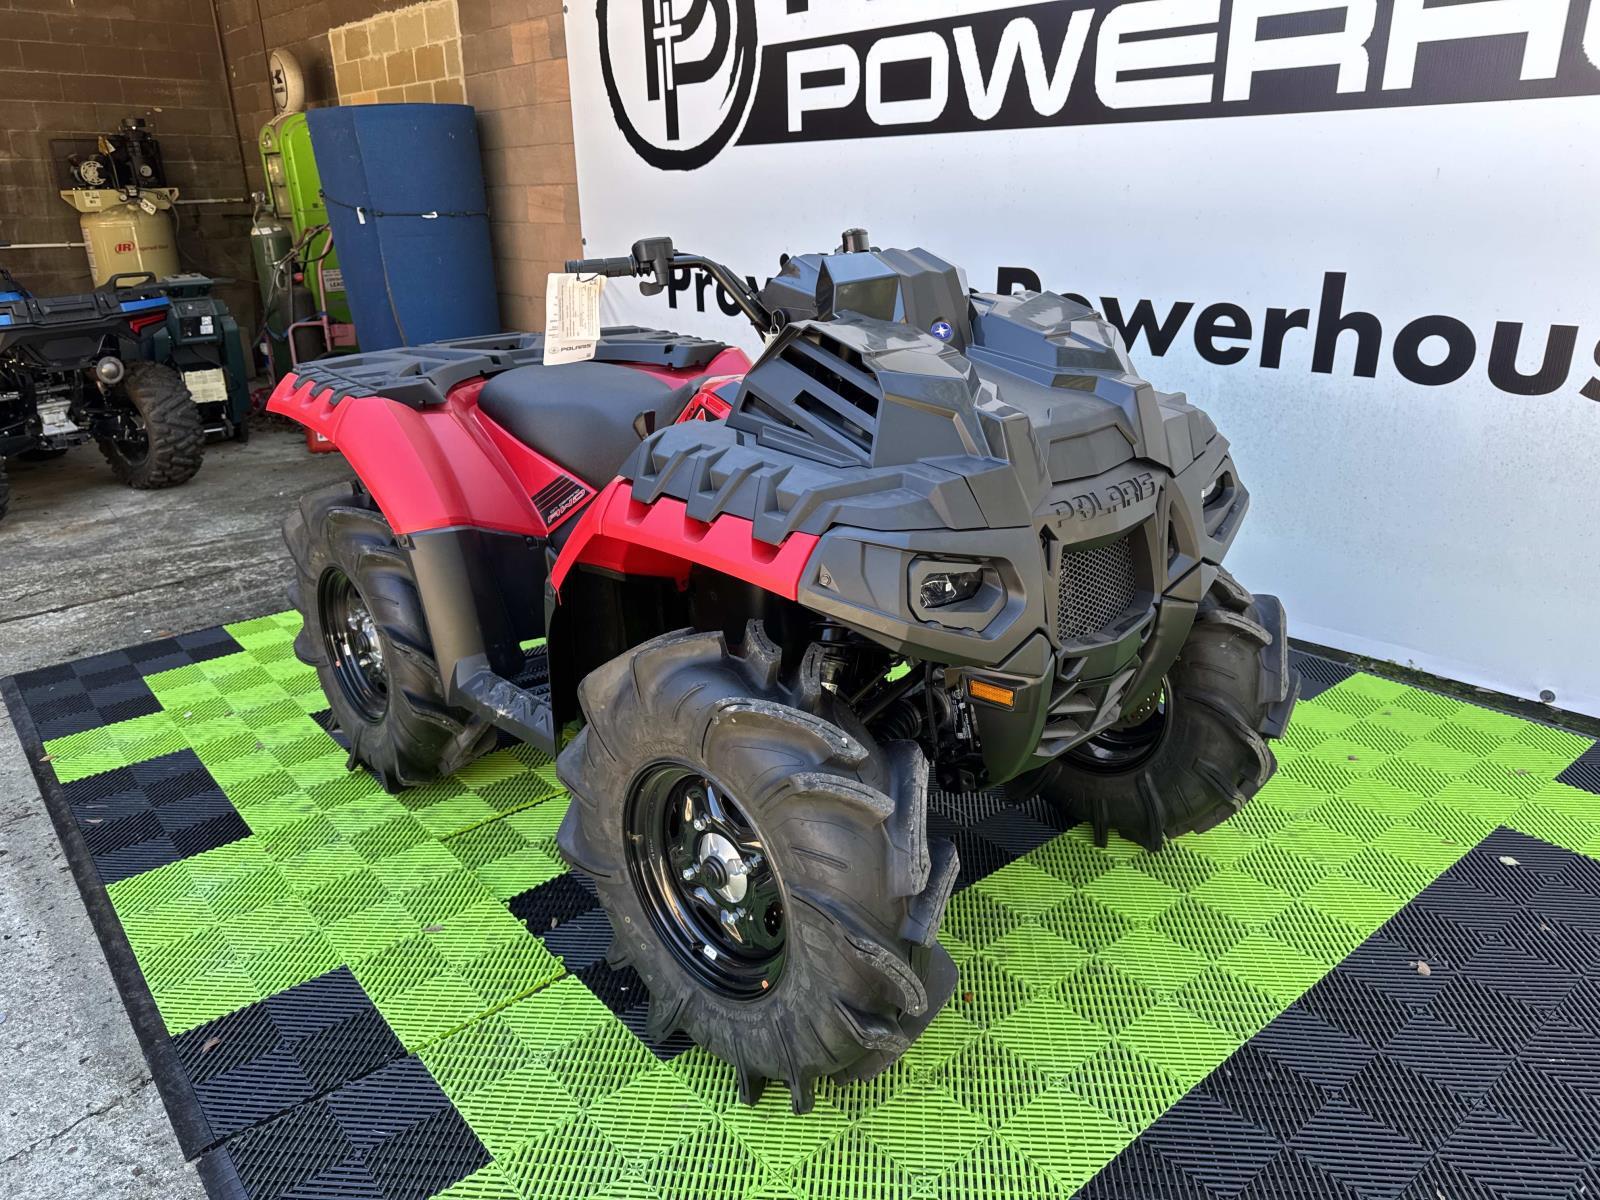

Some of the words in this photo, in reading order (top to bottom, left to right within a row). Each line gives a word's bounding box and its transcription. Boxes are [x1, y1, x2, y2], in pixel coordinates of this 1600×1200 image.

[786, 0, 1600, 132] POWERH
[117, 242, 133, 253] IR
[560, 343, 592, 352] POLARIS
[997, 266, 1600, 403] Pwerhou
[1049, 472, 1156, 528] POLARIS
